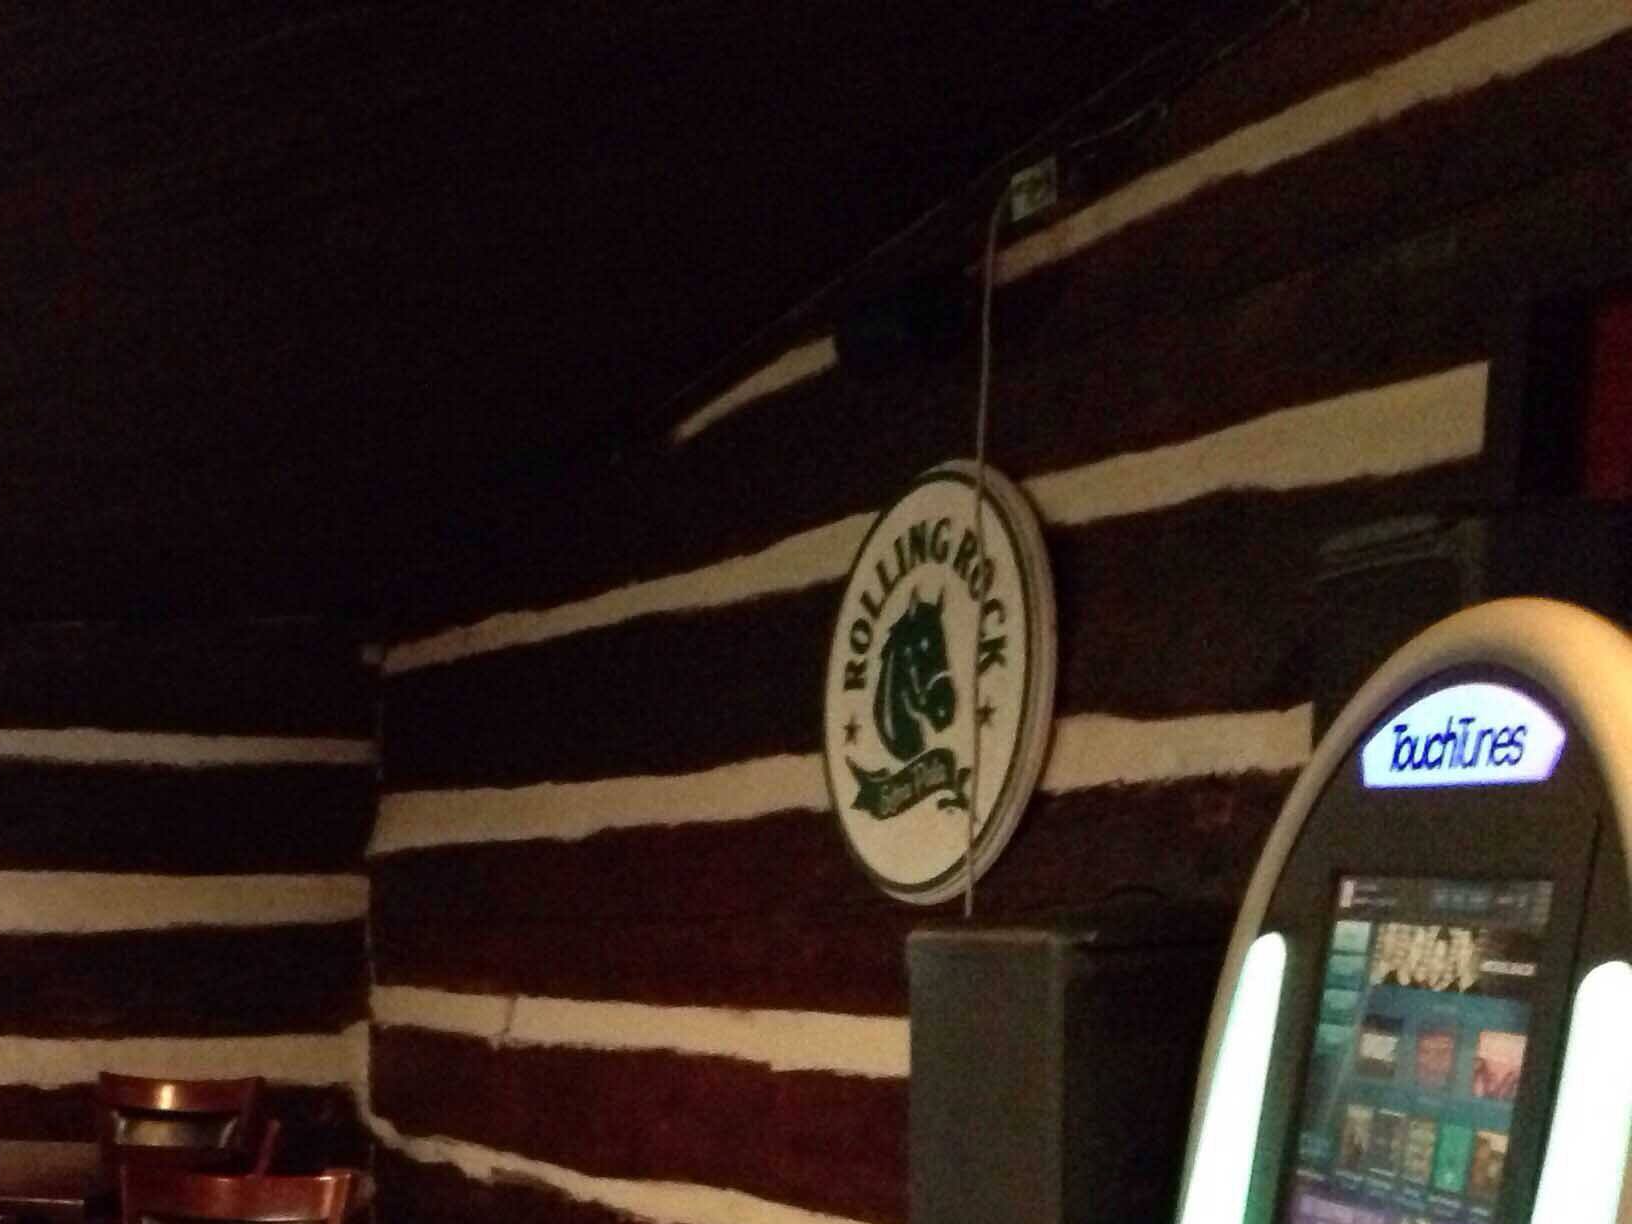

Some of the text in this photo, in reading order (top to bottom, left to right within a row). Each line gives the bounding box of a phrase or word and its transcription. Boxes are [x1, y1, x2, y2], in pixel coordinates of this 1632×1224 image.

[843, 516, 1008, 693] ROLLING ROCK
[1389, 715, 1529, 773] TouchTunes
